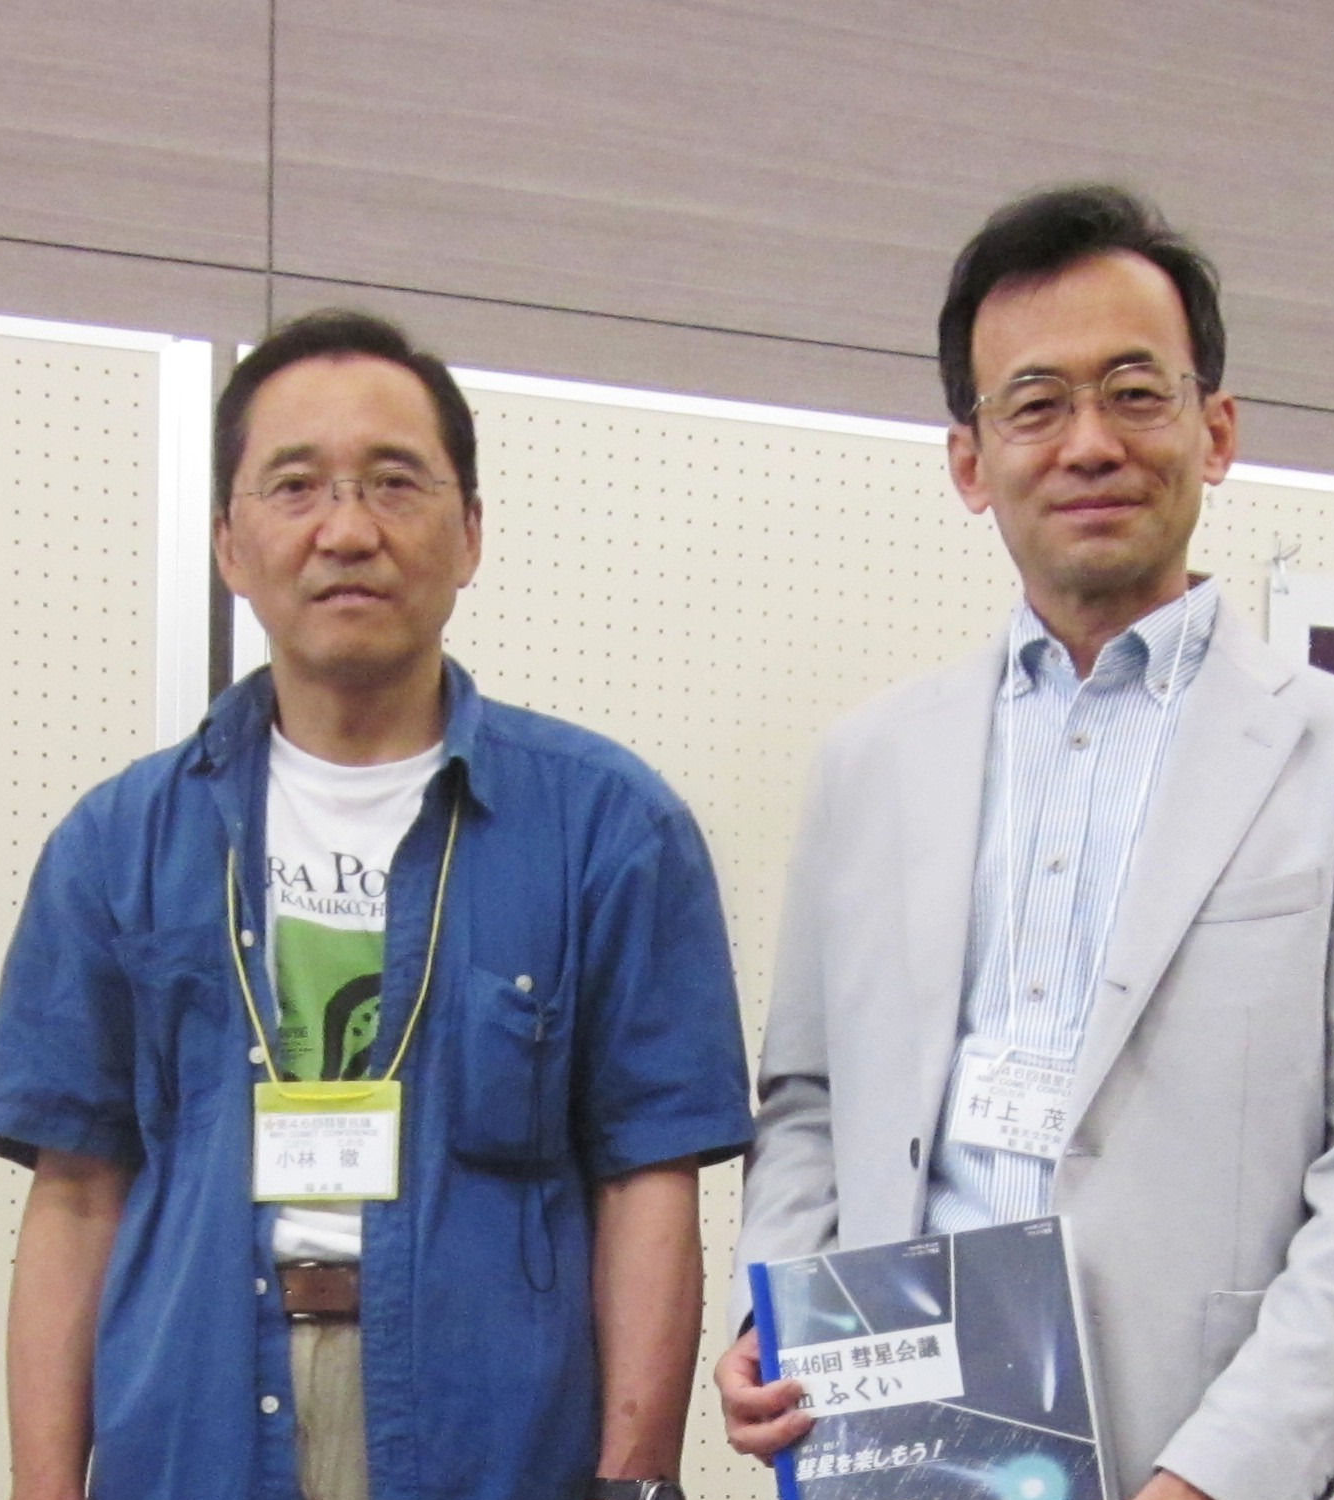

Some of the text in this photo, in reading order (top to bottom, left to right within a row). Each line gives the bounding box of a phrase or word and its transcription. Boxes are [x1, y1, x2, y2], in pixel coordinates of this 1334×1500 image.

[969, 1093, 1068, 1132] 村上 茂
[275, 1149, 317, 1169] 小林
[851, 1334, 942, 1368] 彗星会議
[825, 1376, 903, 1405] ふくい
